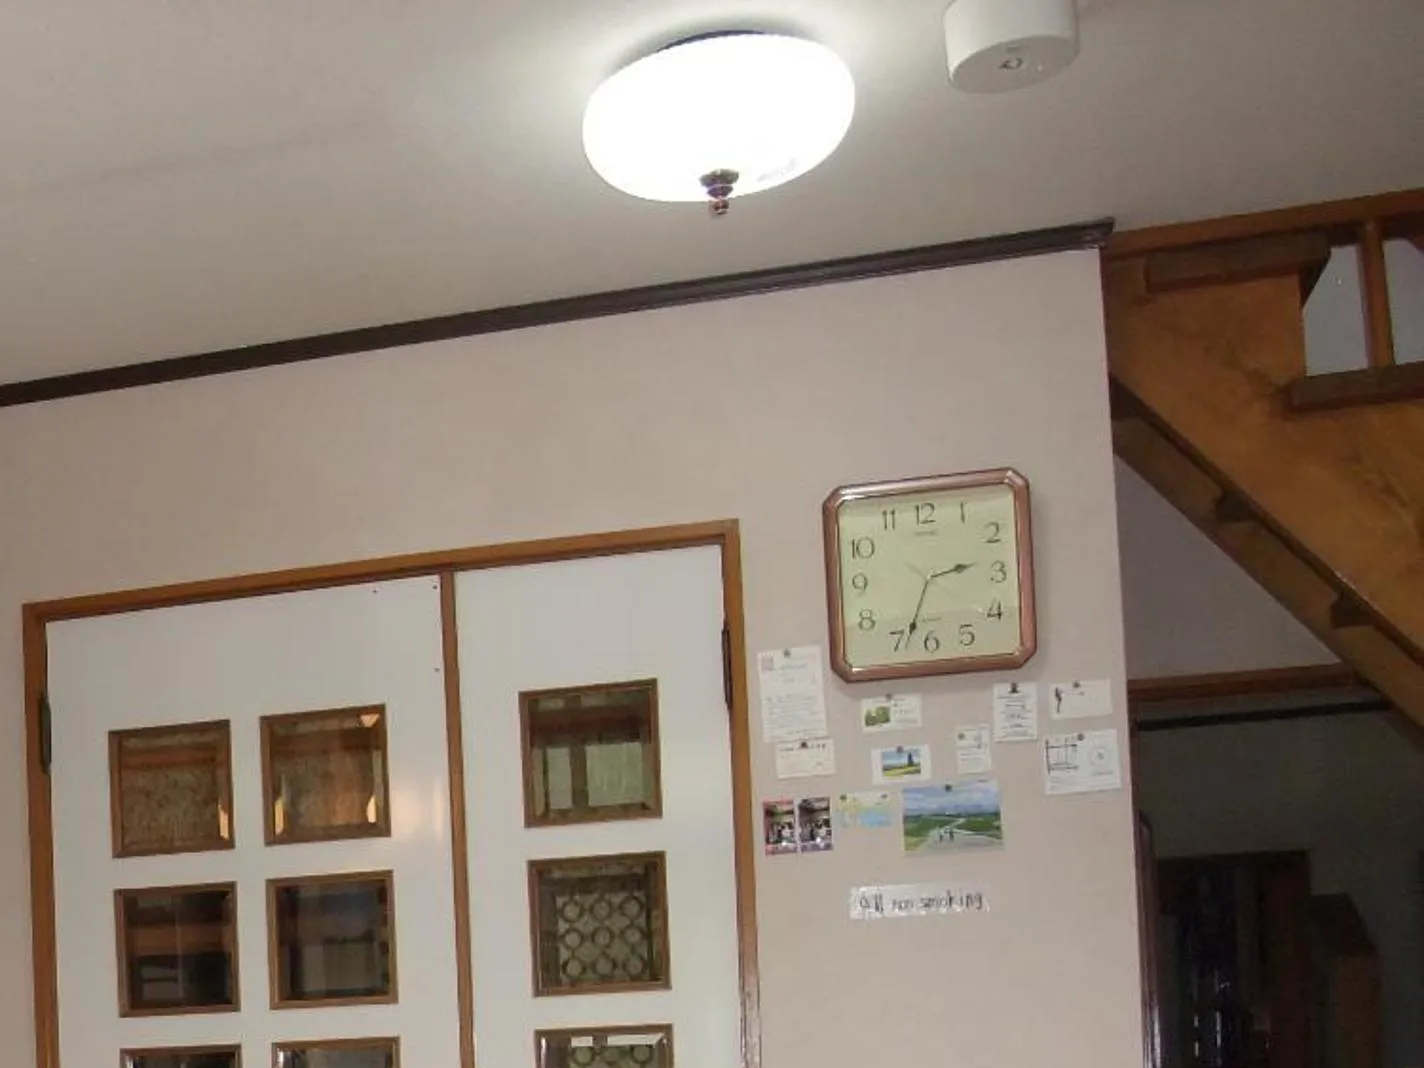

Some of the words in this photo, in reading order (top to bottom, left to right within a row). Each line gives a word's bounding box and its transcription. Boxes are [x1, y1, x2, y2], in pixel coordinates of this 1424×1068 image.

[881, 508, 896, 531] 11
[914, 502, 936, 527] 12
[960, 501, 969, 524] 1
[984, 521, 1002, 545] 2
[851, 535, 876, 560] 10
[989, 560, 1008, 584] 3
[851, 572, 869, 597] 9
[857, 608, 877, 632] 8
[986, 599, 1003, 621] 4
[888, 629, 905, 653] 7
[923, 629, 941, 654] 6
[958, 624, 976, 647] 5
